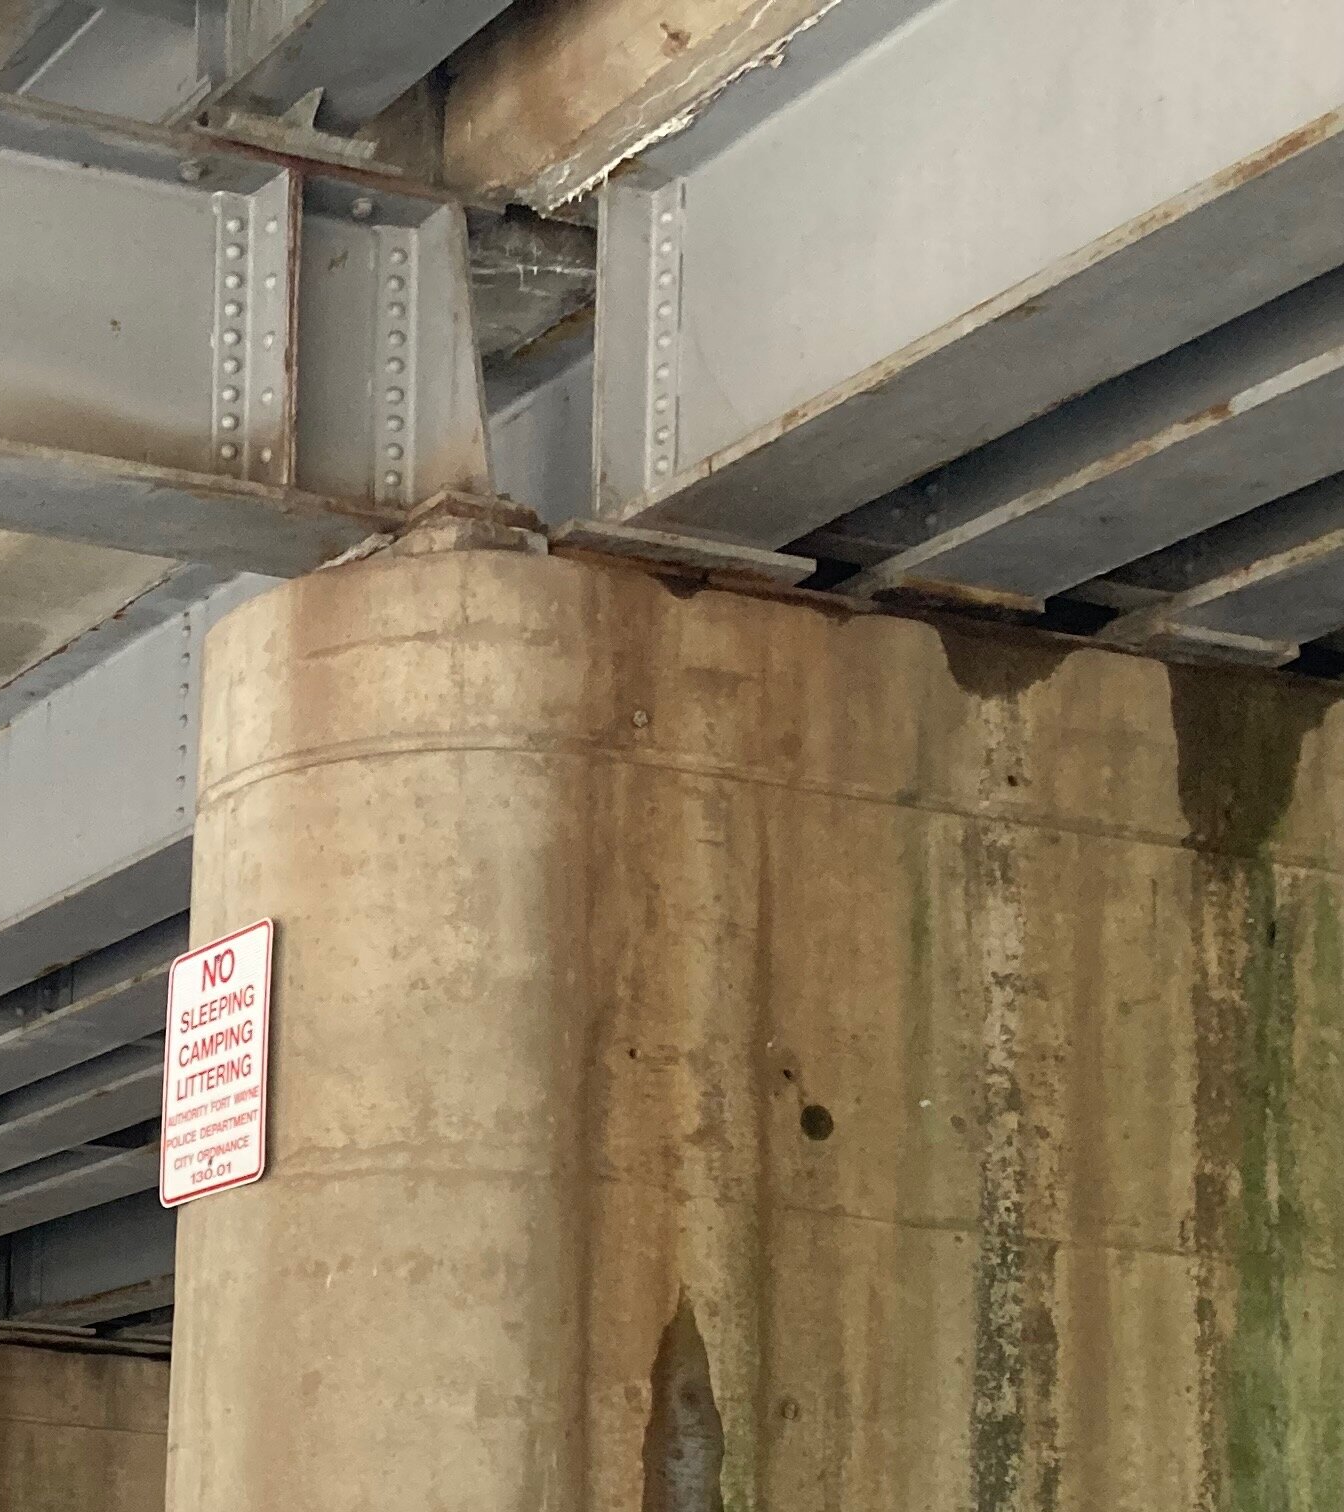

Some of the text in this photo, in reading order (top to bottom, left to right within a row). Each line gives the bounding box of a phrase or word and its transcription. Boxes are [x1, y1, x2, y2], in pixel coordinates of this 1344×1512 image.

[201, 948, 235, 992] NO
[180, 984, 254, 1034] SLEEPING
[179, 1019, 253, 1067] CAMPING
[176, 1053, 252, 1101] LITTERING
[166, 1109, 259, 1151] POLICE DEPARTMENT
[167, 1103, 208, 1127] AUTHORITY
[210, 1096, 231, 1113] FORT
[174, 1135, 250, 1170] CITY ORDINANCE
[191, 1161, 233, 1184] 130.01
